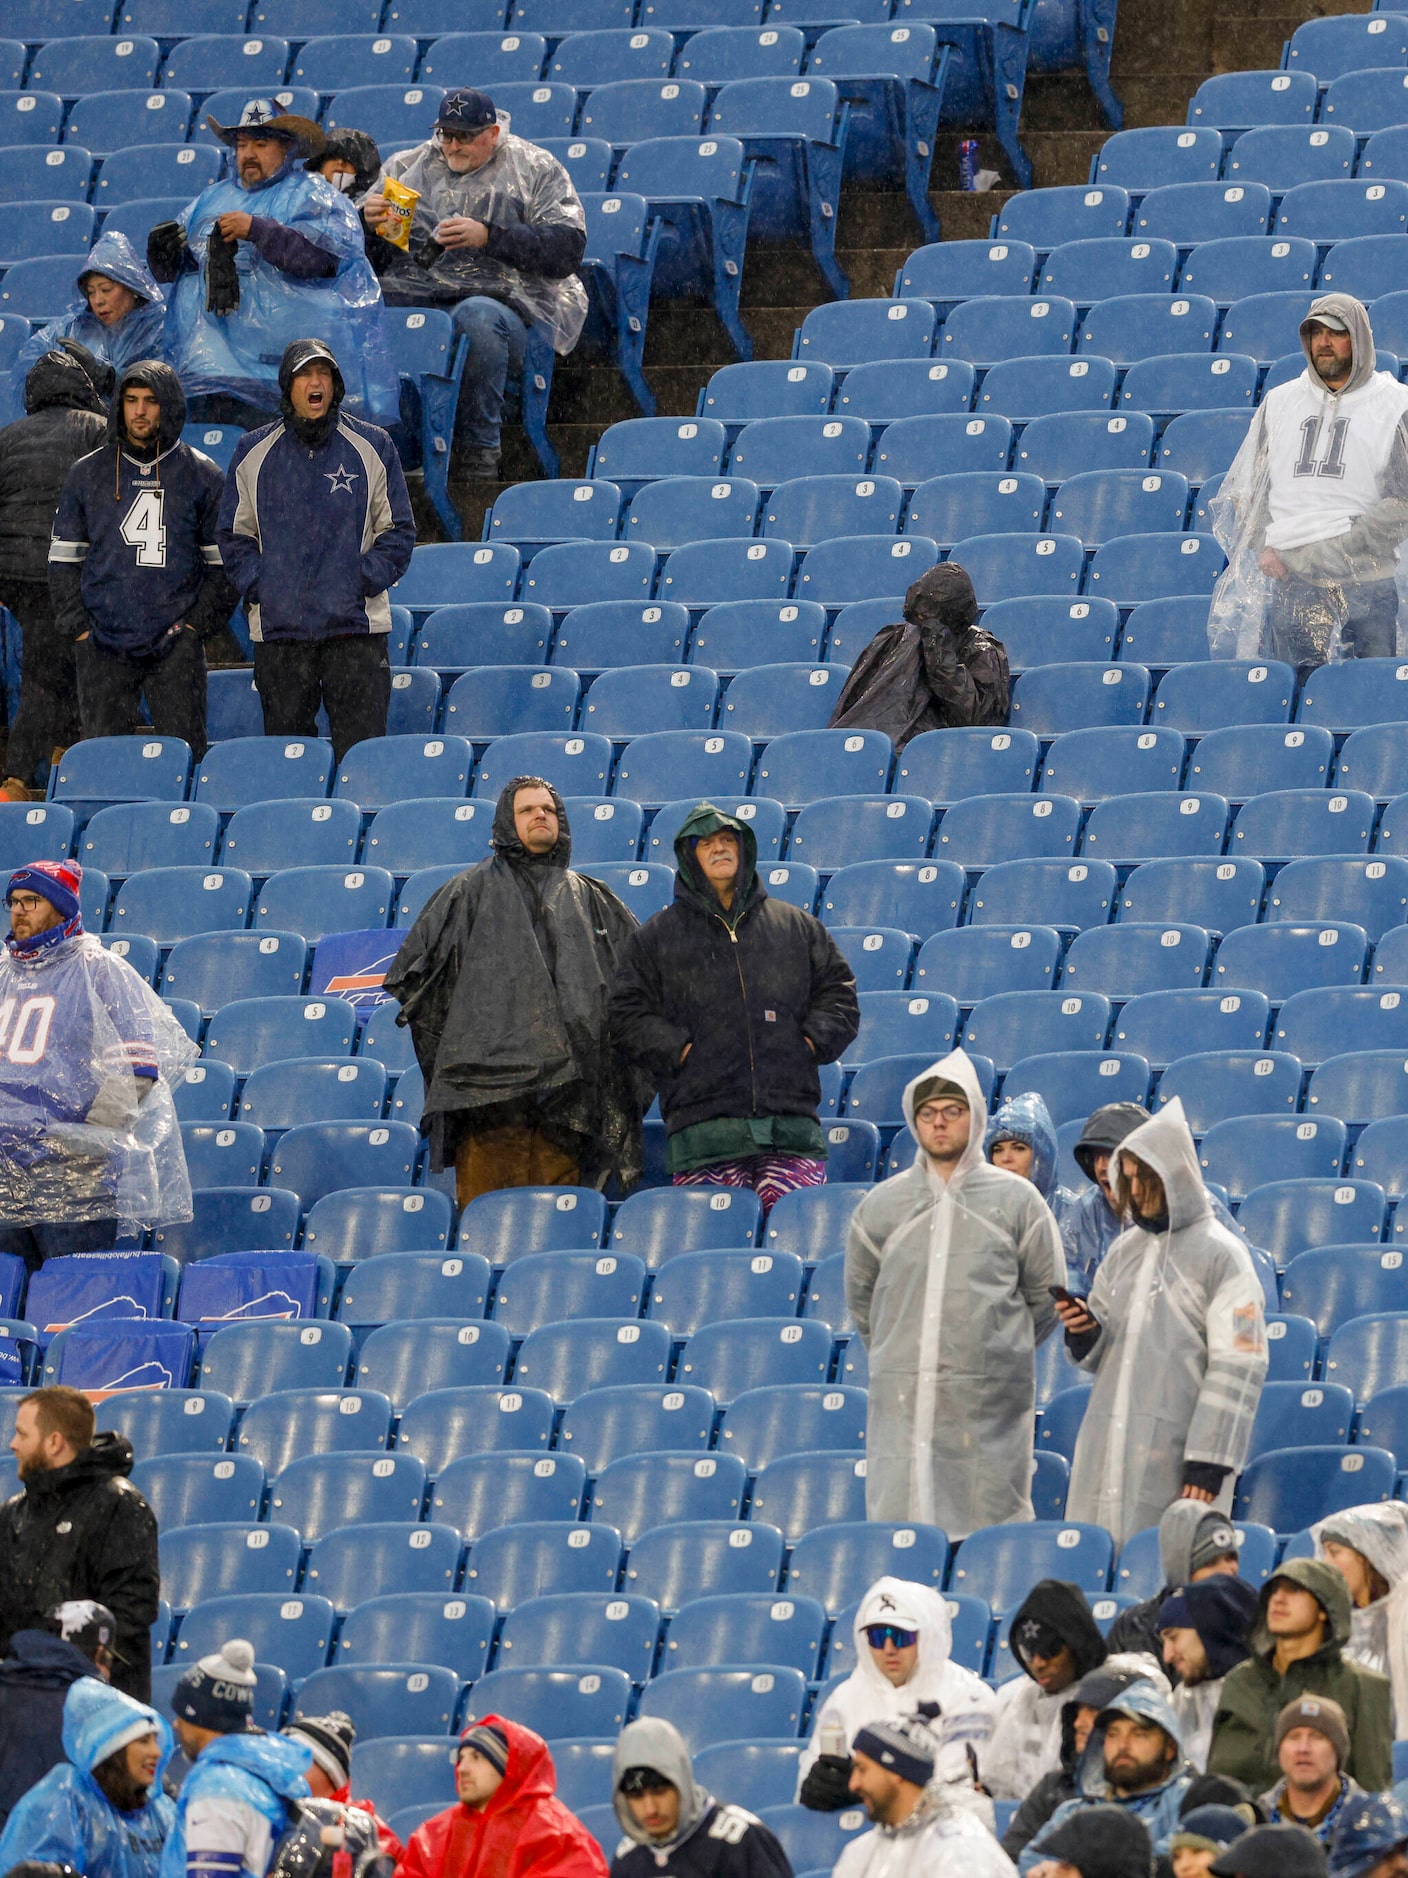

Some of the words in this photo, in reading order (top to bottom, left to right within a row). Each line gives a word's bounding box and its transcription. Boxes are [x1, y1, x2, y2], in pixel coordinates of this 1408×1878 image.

[23, 99, 31, 107] 19
[208, 433, 218, 443] 24
[1294, 415, 1351, 480] 11
[119, 489, 167, 568] 4
[1067, 1002, 1076, 1013] 10
[835, 1130, 844, 1141] 10
[1303, 1126, 1312, 1137] 13
[1341, 1190, 1350, 1201] 14
[716, 1198, 725, 1208] 10
[787, 1329, 797, 1340] 12
[1308, 1394, 1317, 1404] 16
[541, 1463, 551, 1474] 12
[254, 1534, 263, 1545] 11
[416, 1534, 426, 1545] 12
[736, 1533, 746, 1544] 14
[1065, 1534, 1074, 1544] 16
[414, 1677, 423, 1688] 13
